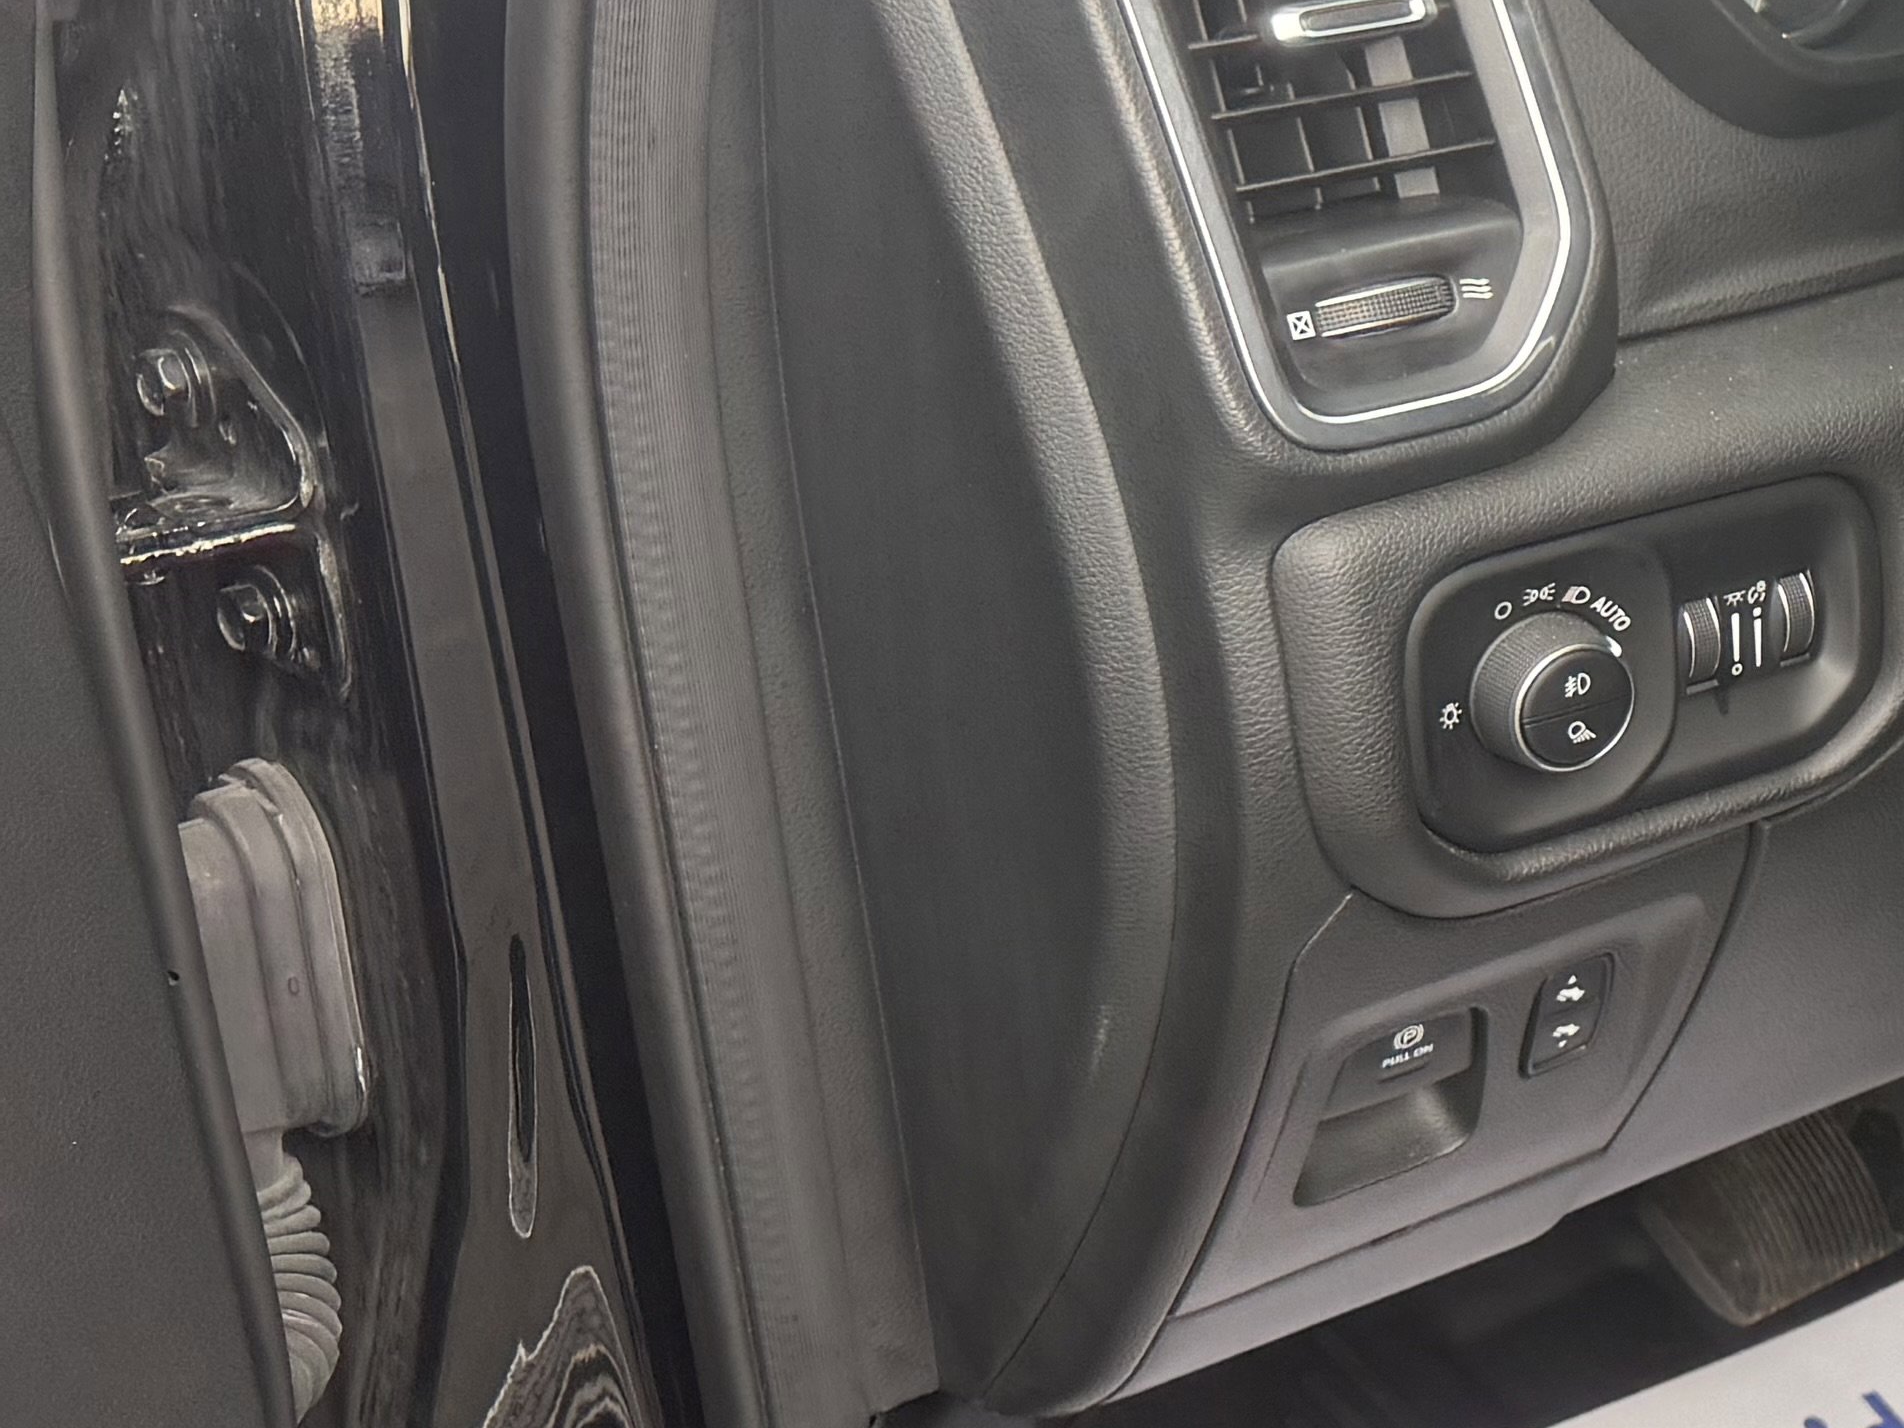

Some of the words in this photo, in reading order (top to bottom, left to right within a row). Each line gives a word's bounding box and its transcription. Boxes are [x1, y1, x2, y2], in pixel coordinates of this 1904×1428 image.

[1590, 596, 1631, 631] AUTO
[1382, 1052, 1410, 1068] PULL
[1413, 1044, 1434, 1057] ON
